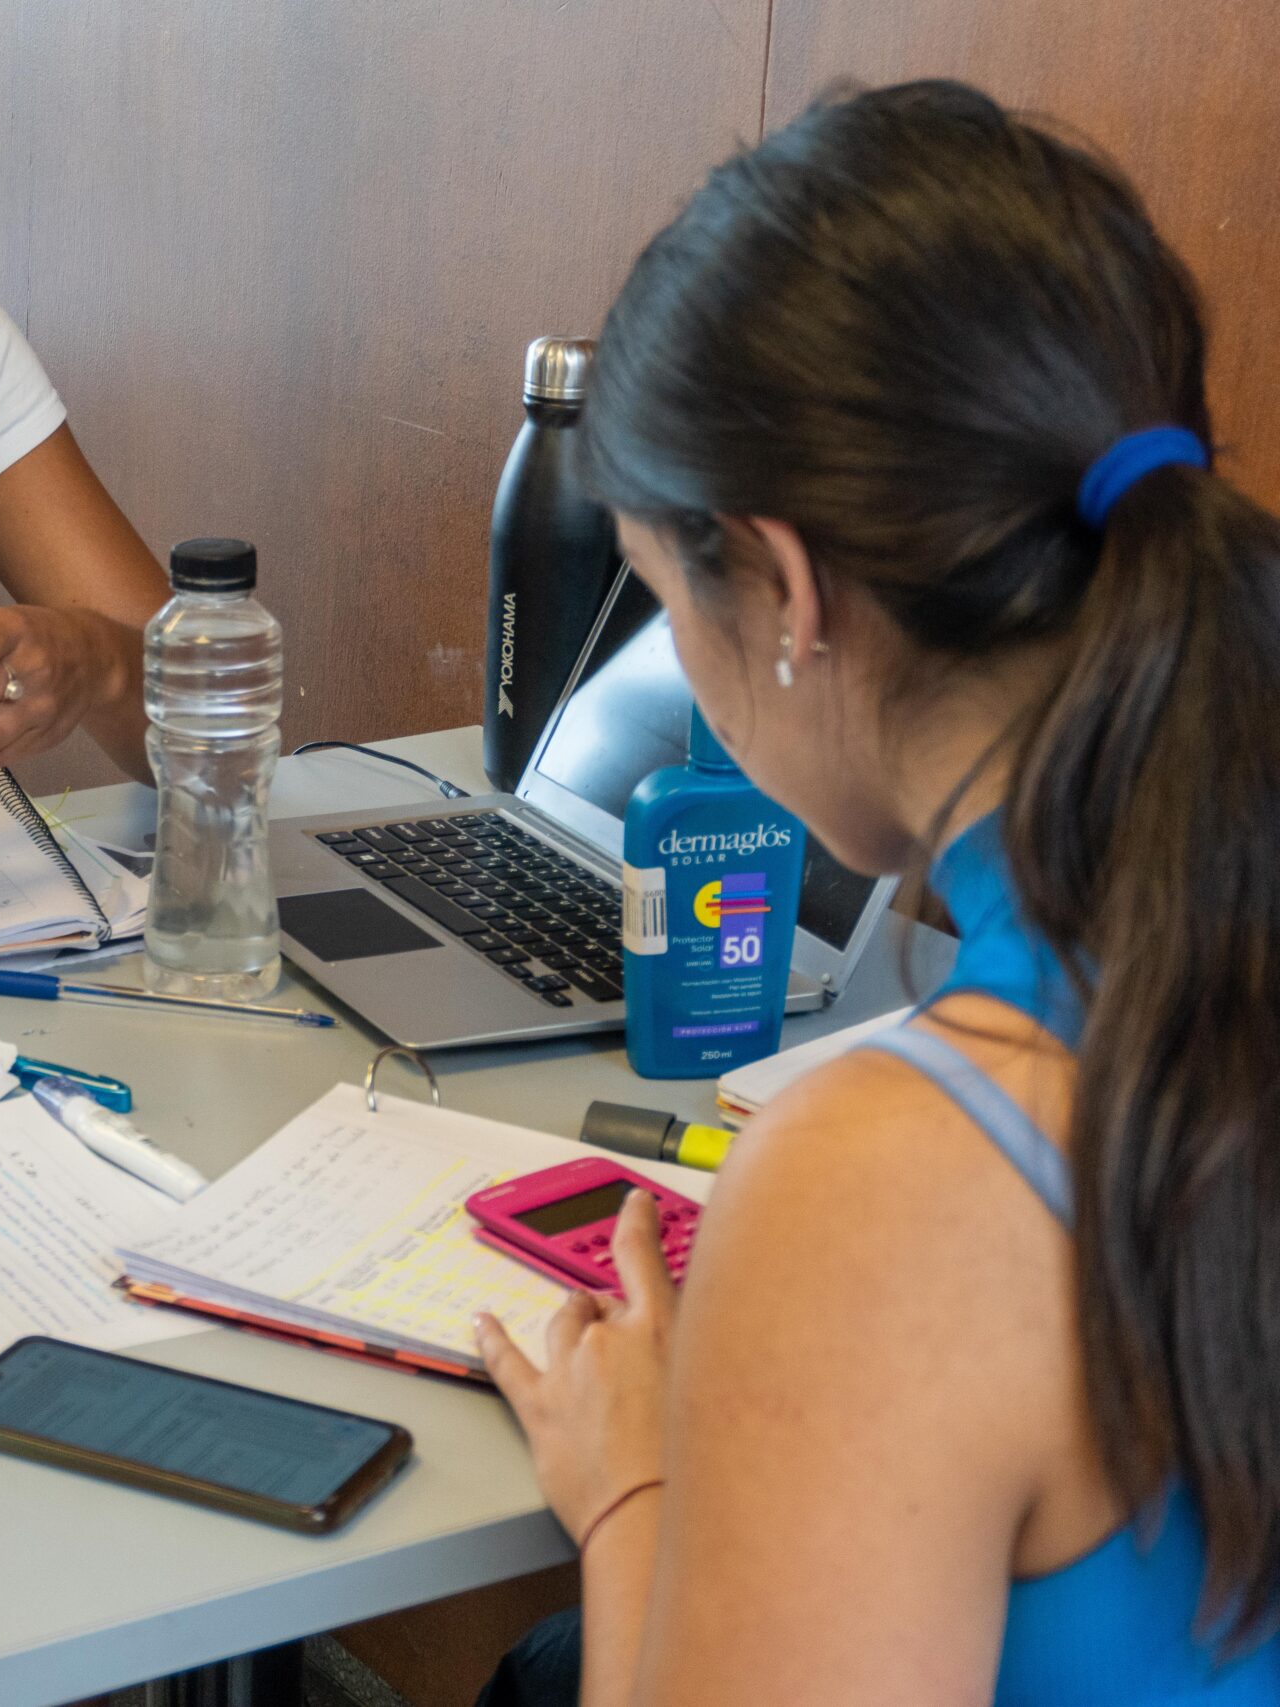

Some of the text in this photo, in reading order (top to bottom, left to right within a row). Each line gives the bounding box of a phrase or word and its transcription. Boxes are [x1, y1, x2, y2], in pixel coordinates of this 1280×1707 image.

[500, 592, 516, 685] YOKOHAMA
[658, 823, 791, 855] dermaglós
[672, 854, 726, 866] SOLAR
[672, 936, 714, 944] Protector
[723, 935, 760, 965] 50
